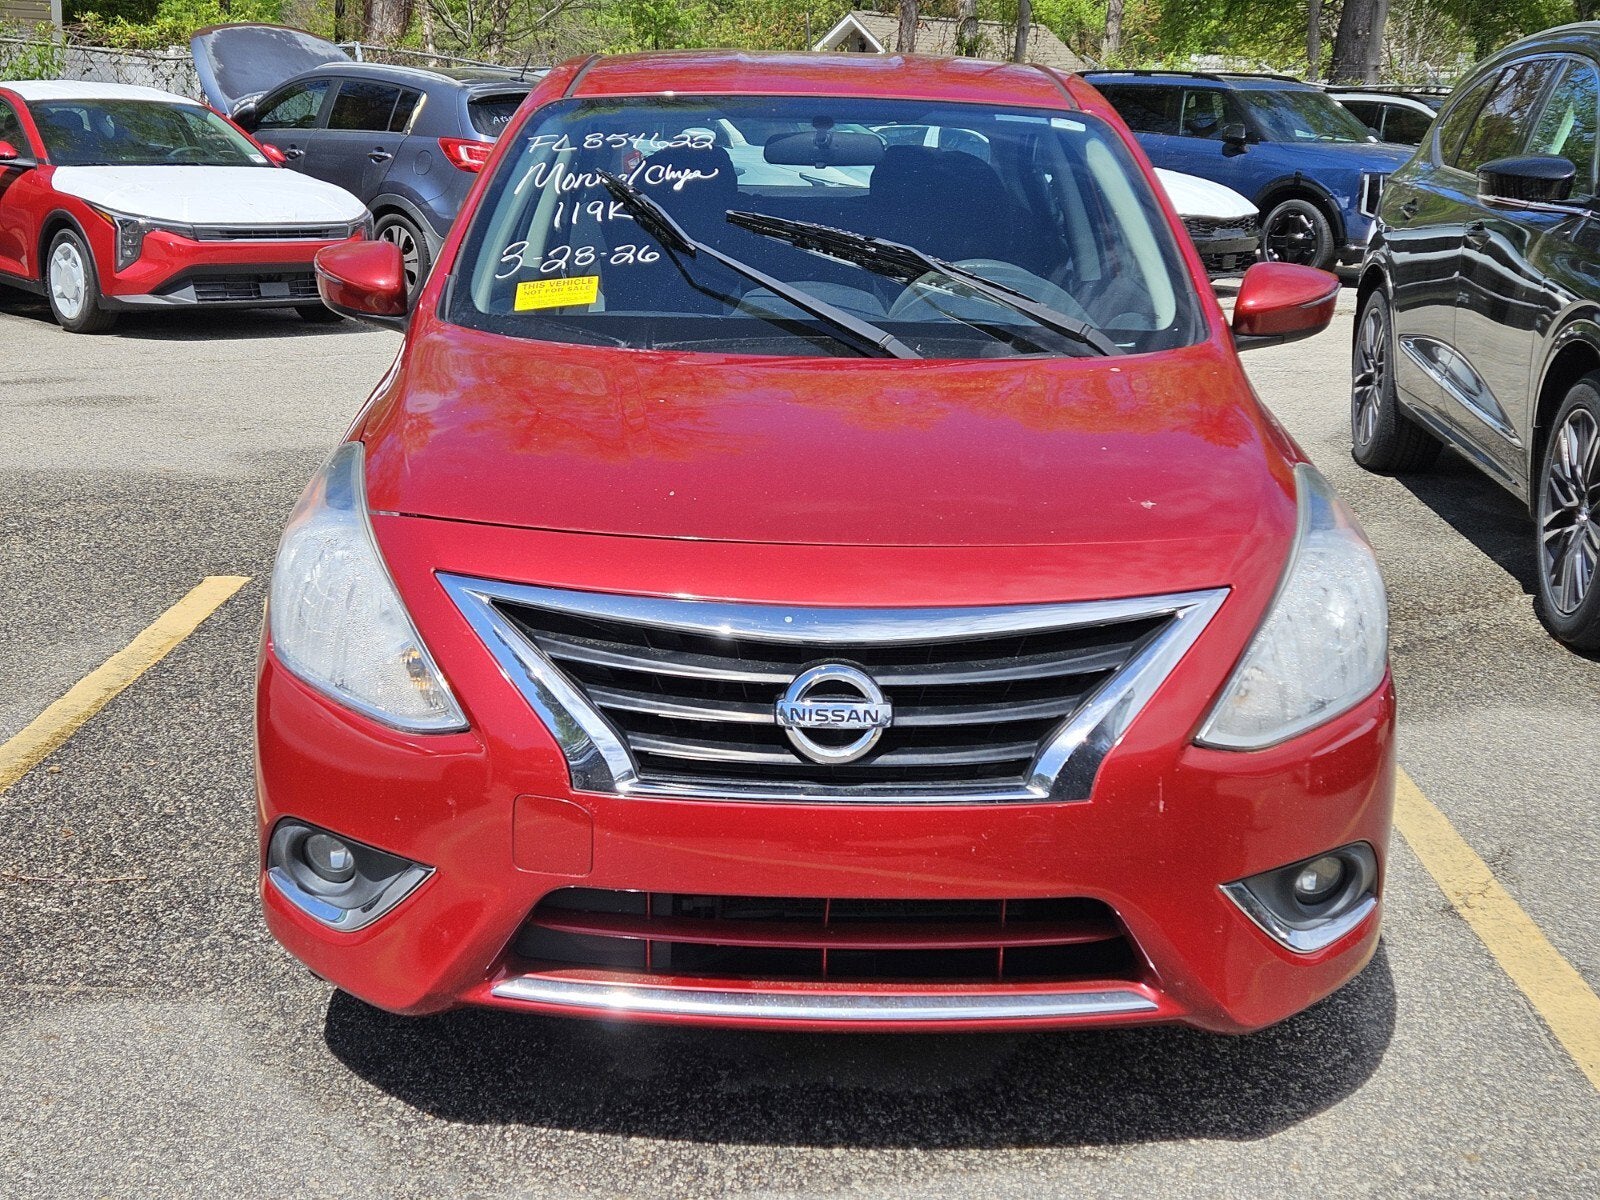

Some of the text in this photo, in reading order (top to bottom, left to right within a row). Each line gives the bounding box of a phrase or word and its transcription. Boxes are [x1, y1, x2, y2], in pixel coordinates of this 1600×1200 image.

[553, 200, 634, 229] 119K
[494, 240, 660, 279] 3-28-26
[521, 277, 594, 291] THIS VEHICLE
[790, 707, 879, 723] NISSAN
